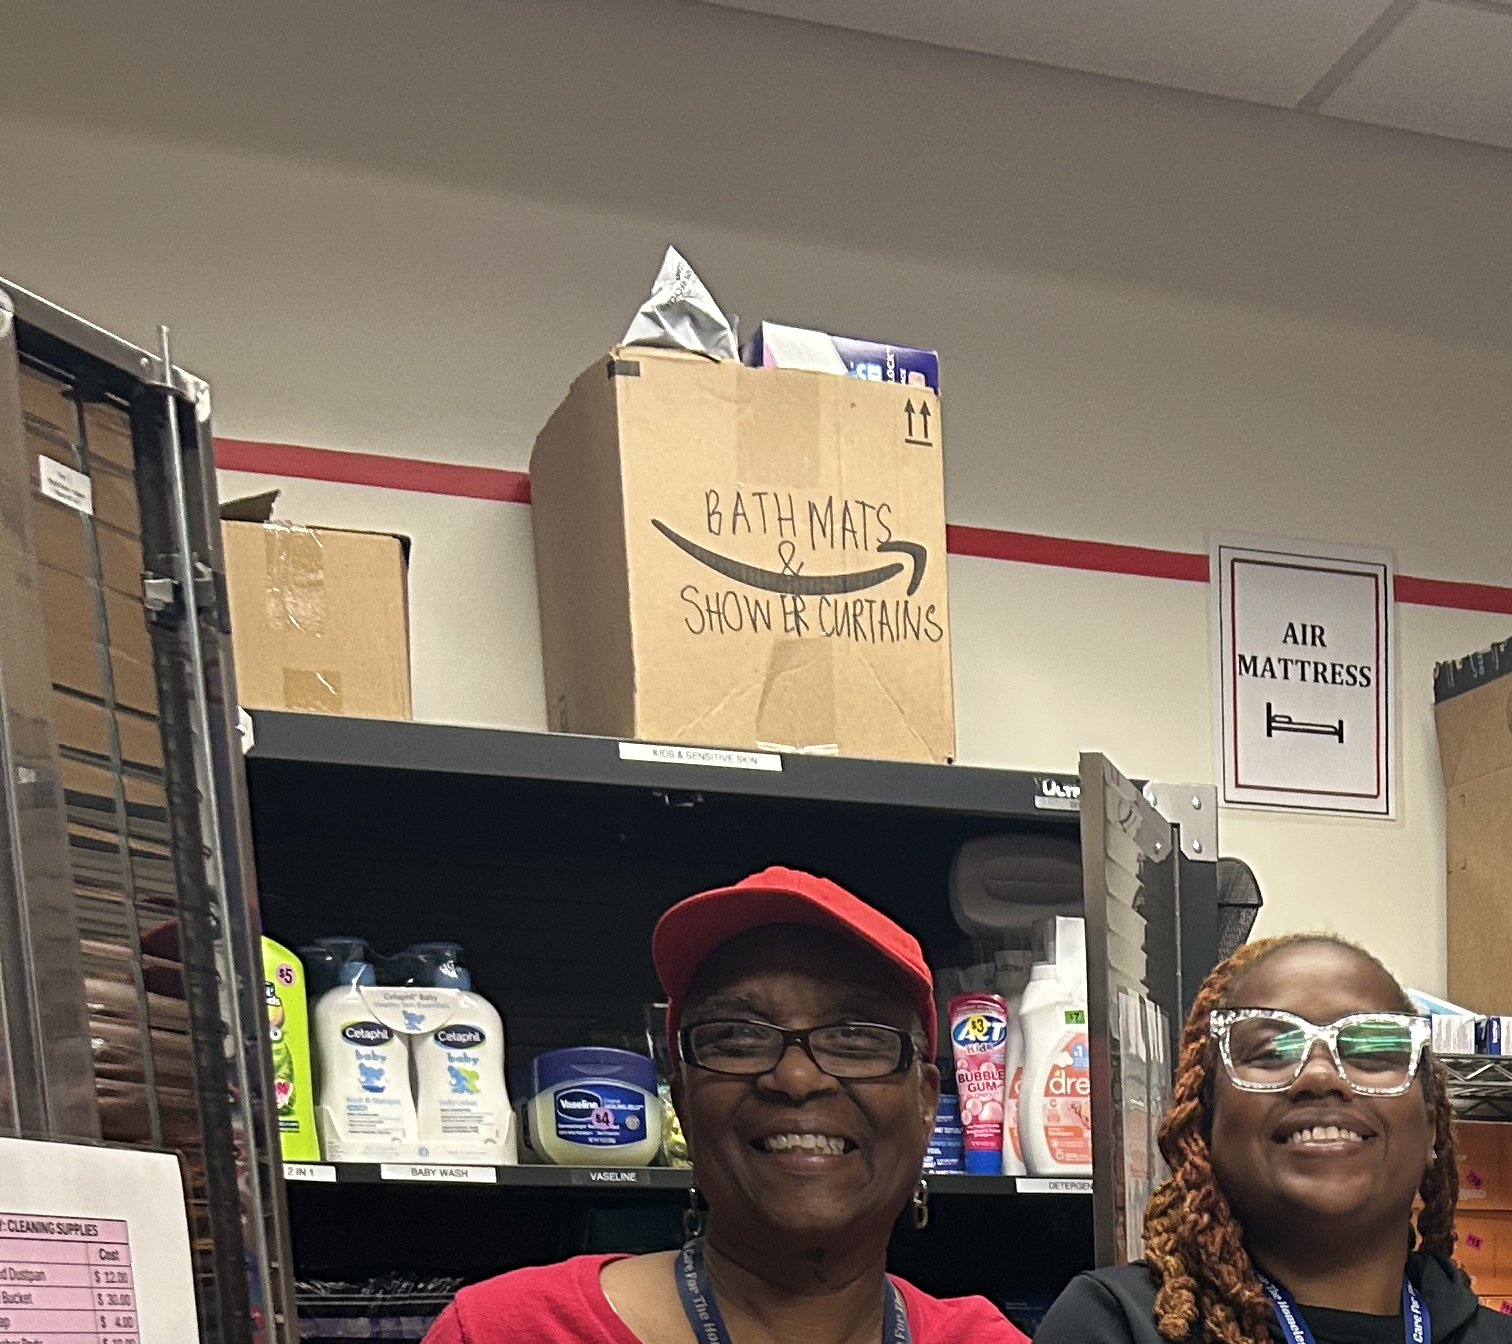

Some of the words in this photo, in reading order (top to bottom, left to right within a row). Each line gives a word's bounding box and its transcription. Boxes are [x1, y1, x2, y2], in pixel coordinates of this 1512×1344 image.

[705, 489, 797, 538] BATH
[808, 495, 893, 551] MATS
[777, 540, 805, 577] &
[680, 585, 809, 639] SHOWER
[818, 596, 944, 646] CURTAINS
[1282, 622, 1327, 648] AIR
[1237, 653, 1372, 689] MATTRESS
[652, 748, 675, 760] KIDS
[686, 750, 734, 764] SENSITIVE
[736, 754, 759, 766] SKIN
[279, 966, 293, 984] $5
[958, 1021, 1007, 1044] ACT
[971, 1018, 985, 1033] $3
[345, 1026, 394, 1041] Cetaphil
[437, 1029, 481, 1044] Cetaphil
[355, 1049, 387, 1063] baby
[447, 1052, 479, 1067] baby
[957, 1070, 1005, 1084] BUBBLE
[967, 1081, 997, 1093] GUM
[560, 1098, 599, 1110] Vaseline
[411, 1168, 437, 1177] BABY
[439, 1169, 468, 1178] WASH
[590, 1172, 637, 1182] VASELINE
[7, 1219, 55, 1235] CLEANING
[56, 1222, 99, 1237] SUPPLIES
[99, 1248, 120, 1261] Cost
[9, 1267, 46, 1283] Dustpan
[1413, 1314, 1424, 1343] Care
